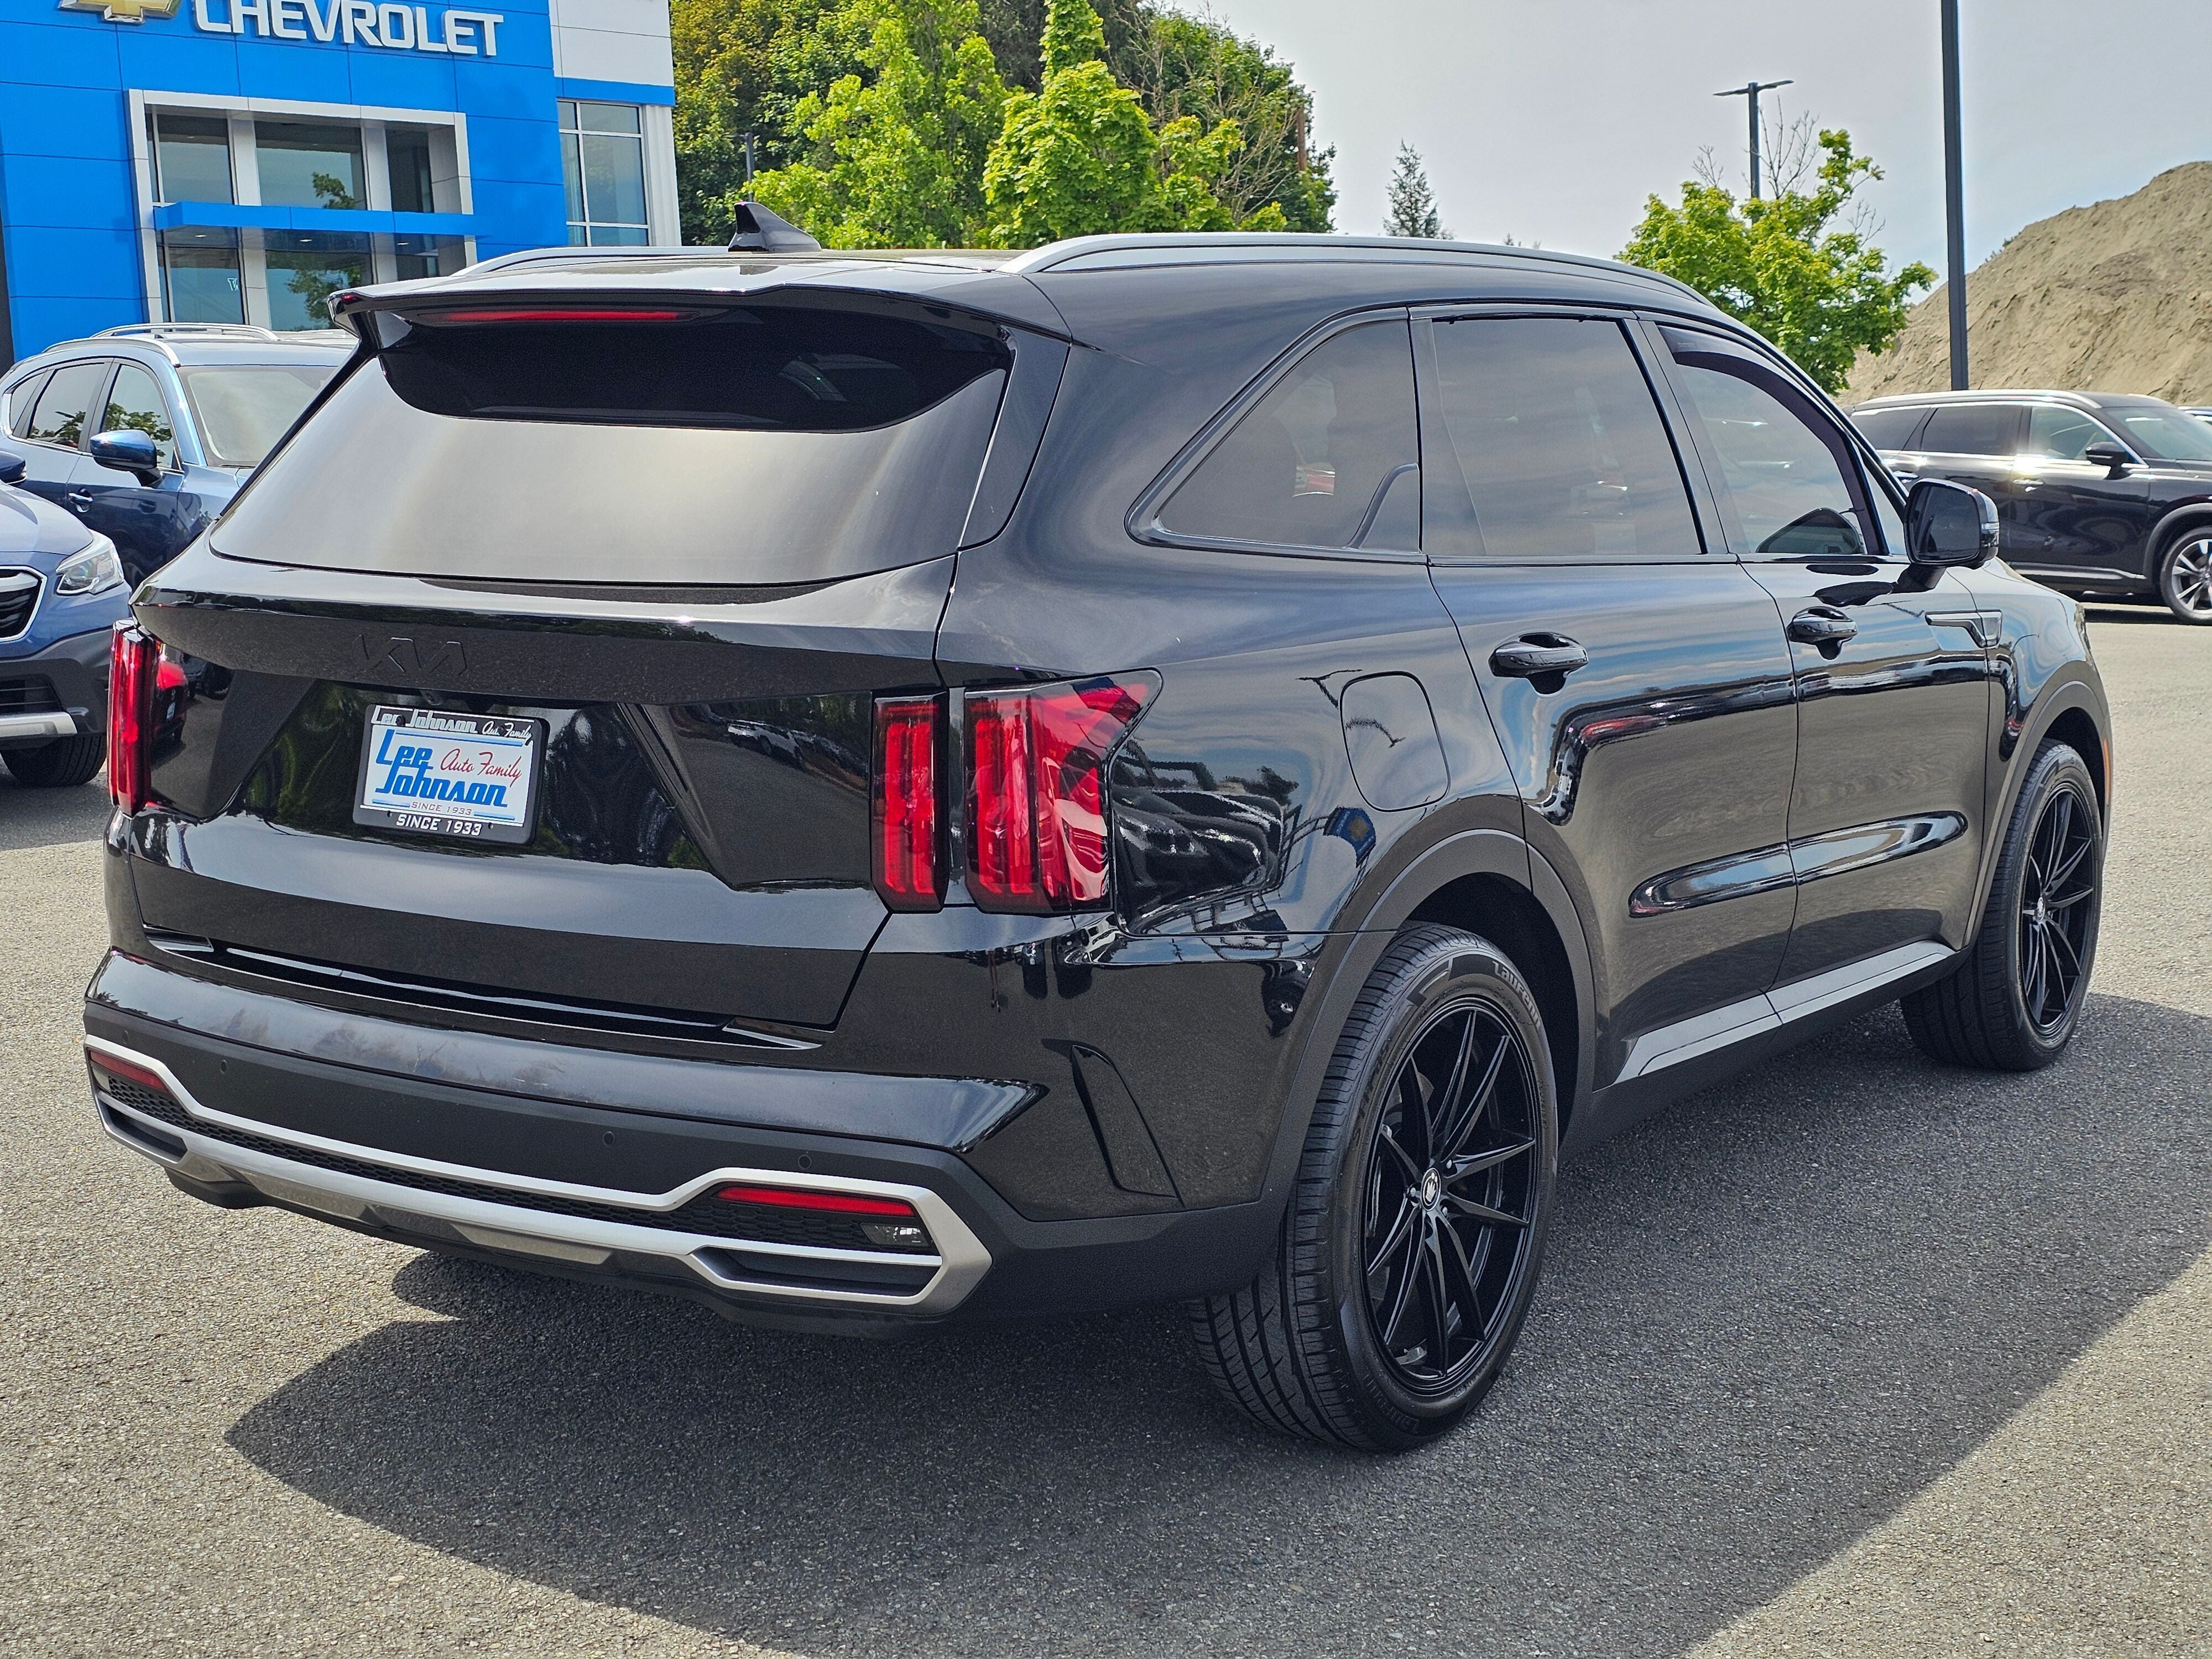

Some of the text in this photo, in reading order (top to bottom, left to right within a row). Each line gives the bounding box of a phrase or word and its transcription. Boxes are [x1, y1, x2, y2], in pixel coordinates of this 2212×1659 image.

[194, 0, 504, 56] CHEVROLET
[405, 708, 478, 734] Johnson
[375, 729, 434, 768] Lee
[440, 748, 522, 787] Auto Family
[375, 764, 508, 807] Johnson
[396, 814, 483, 836] SINCE 1933
[411, 802, 473, 816] SINCE 1933
